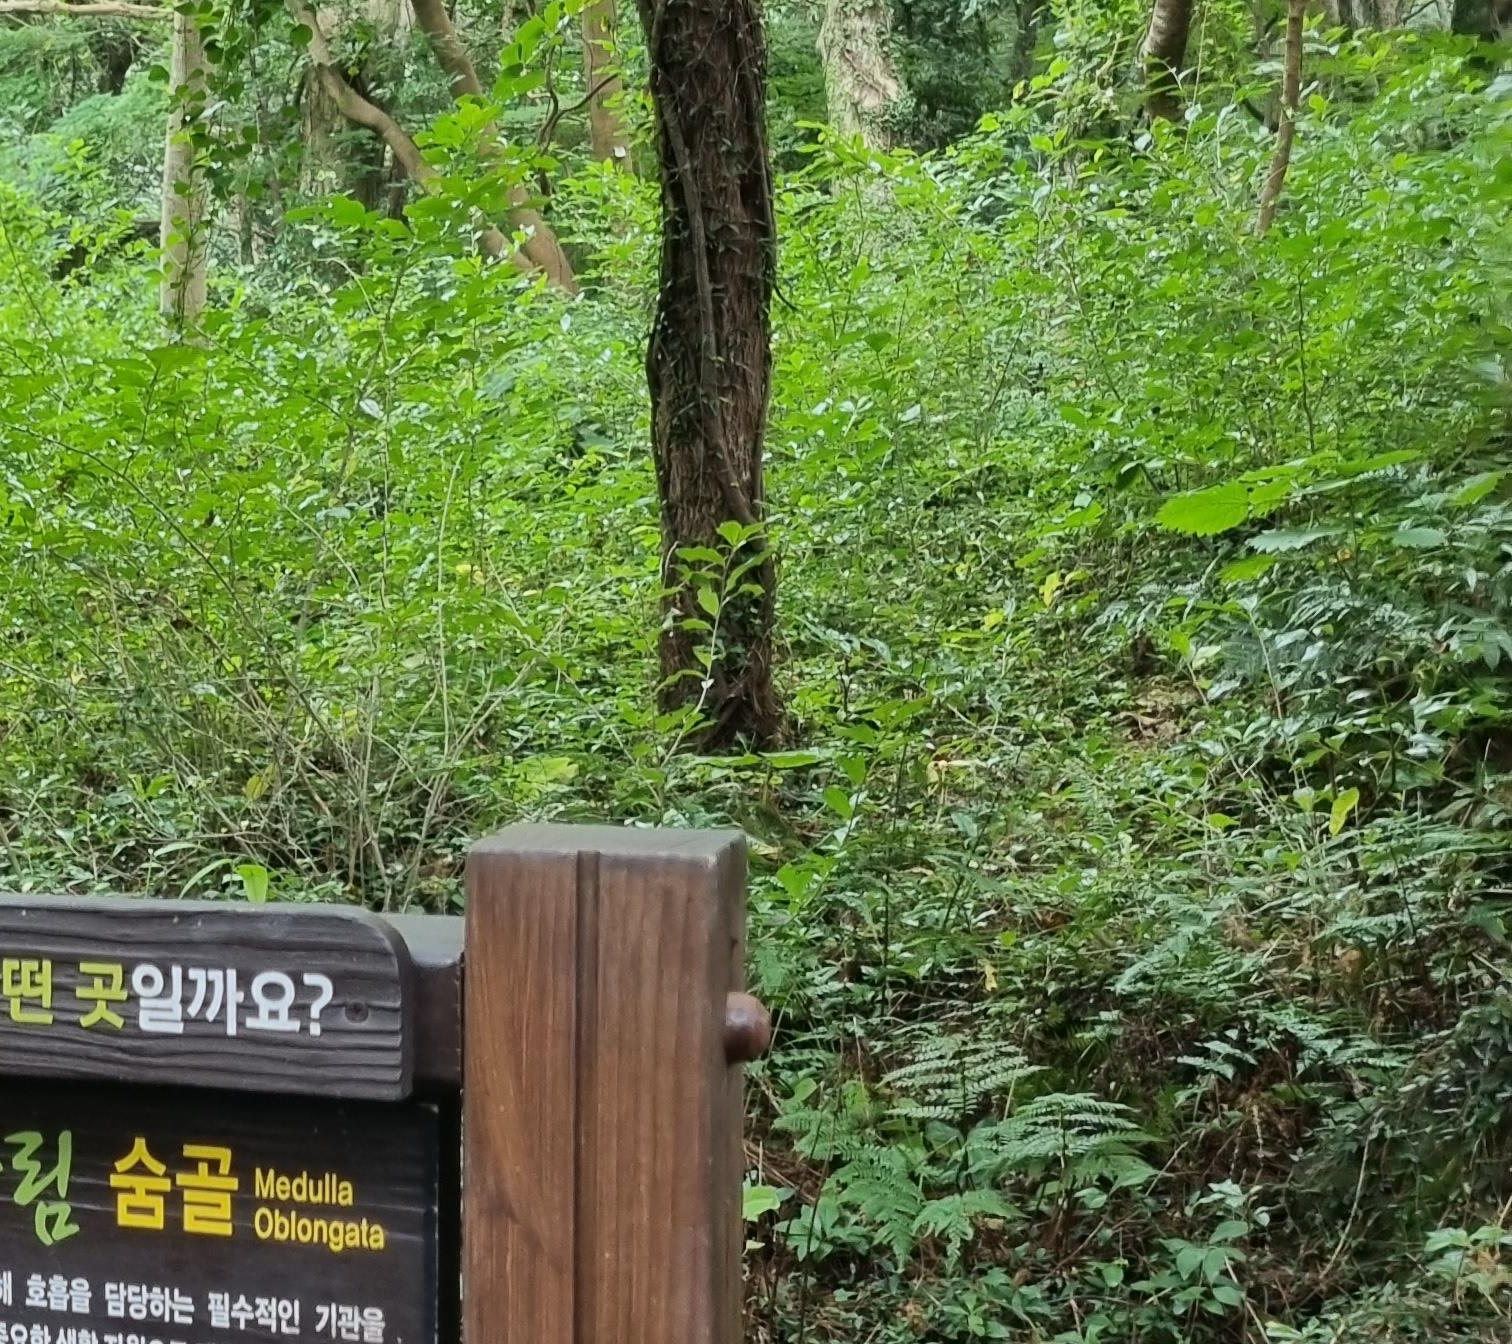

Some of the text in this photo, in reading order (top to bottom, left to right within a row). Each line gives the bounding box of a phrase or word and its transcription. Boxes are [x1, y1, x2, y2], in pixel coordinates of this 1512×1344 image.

[75, 962, 334, 1037] 곳일까요?
[109, 1138, 239, 1236] 숨골
[255, 1167, 353, 1206] Medulla
[254, 1207, 385, 1252] Oblongata
[25, 1273, 92, 1314] 호흡을
[104, 1282, 195, 1325] 담당하는
[207, 1292, 300, 1335] 필수적인
[315, 1302, 386, 1344] 기관을
